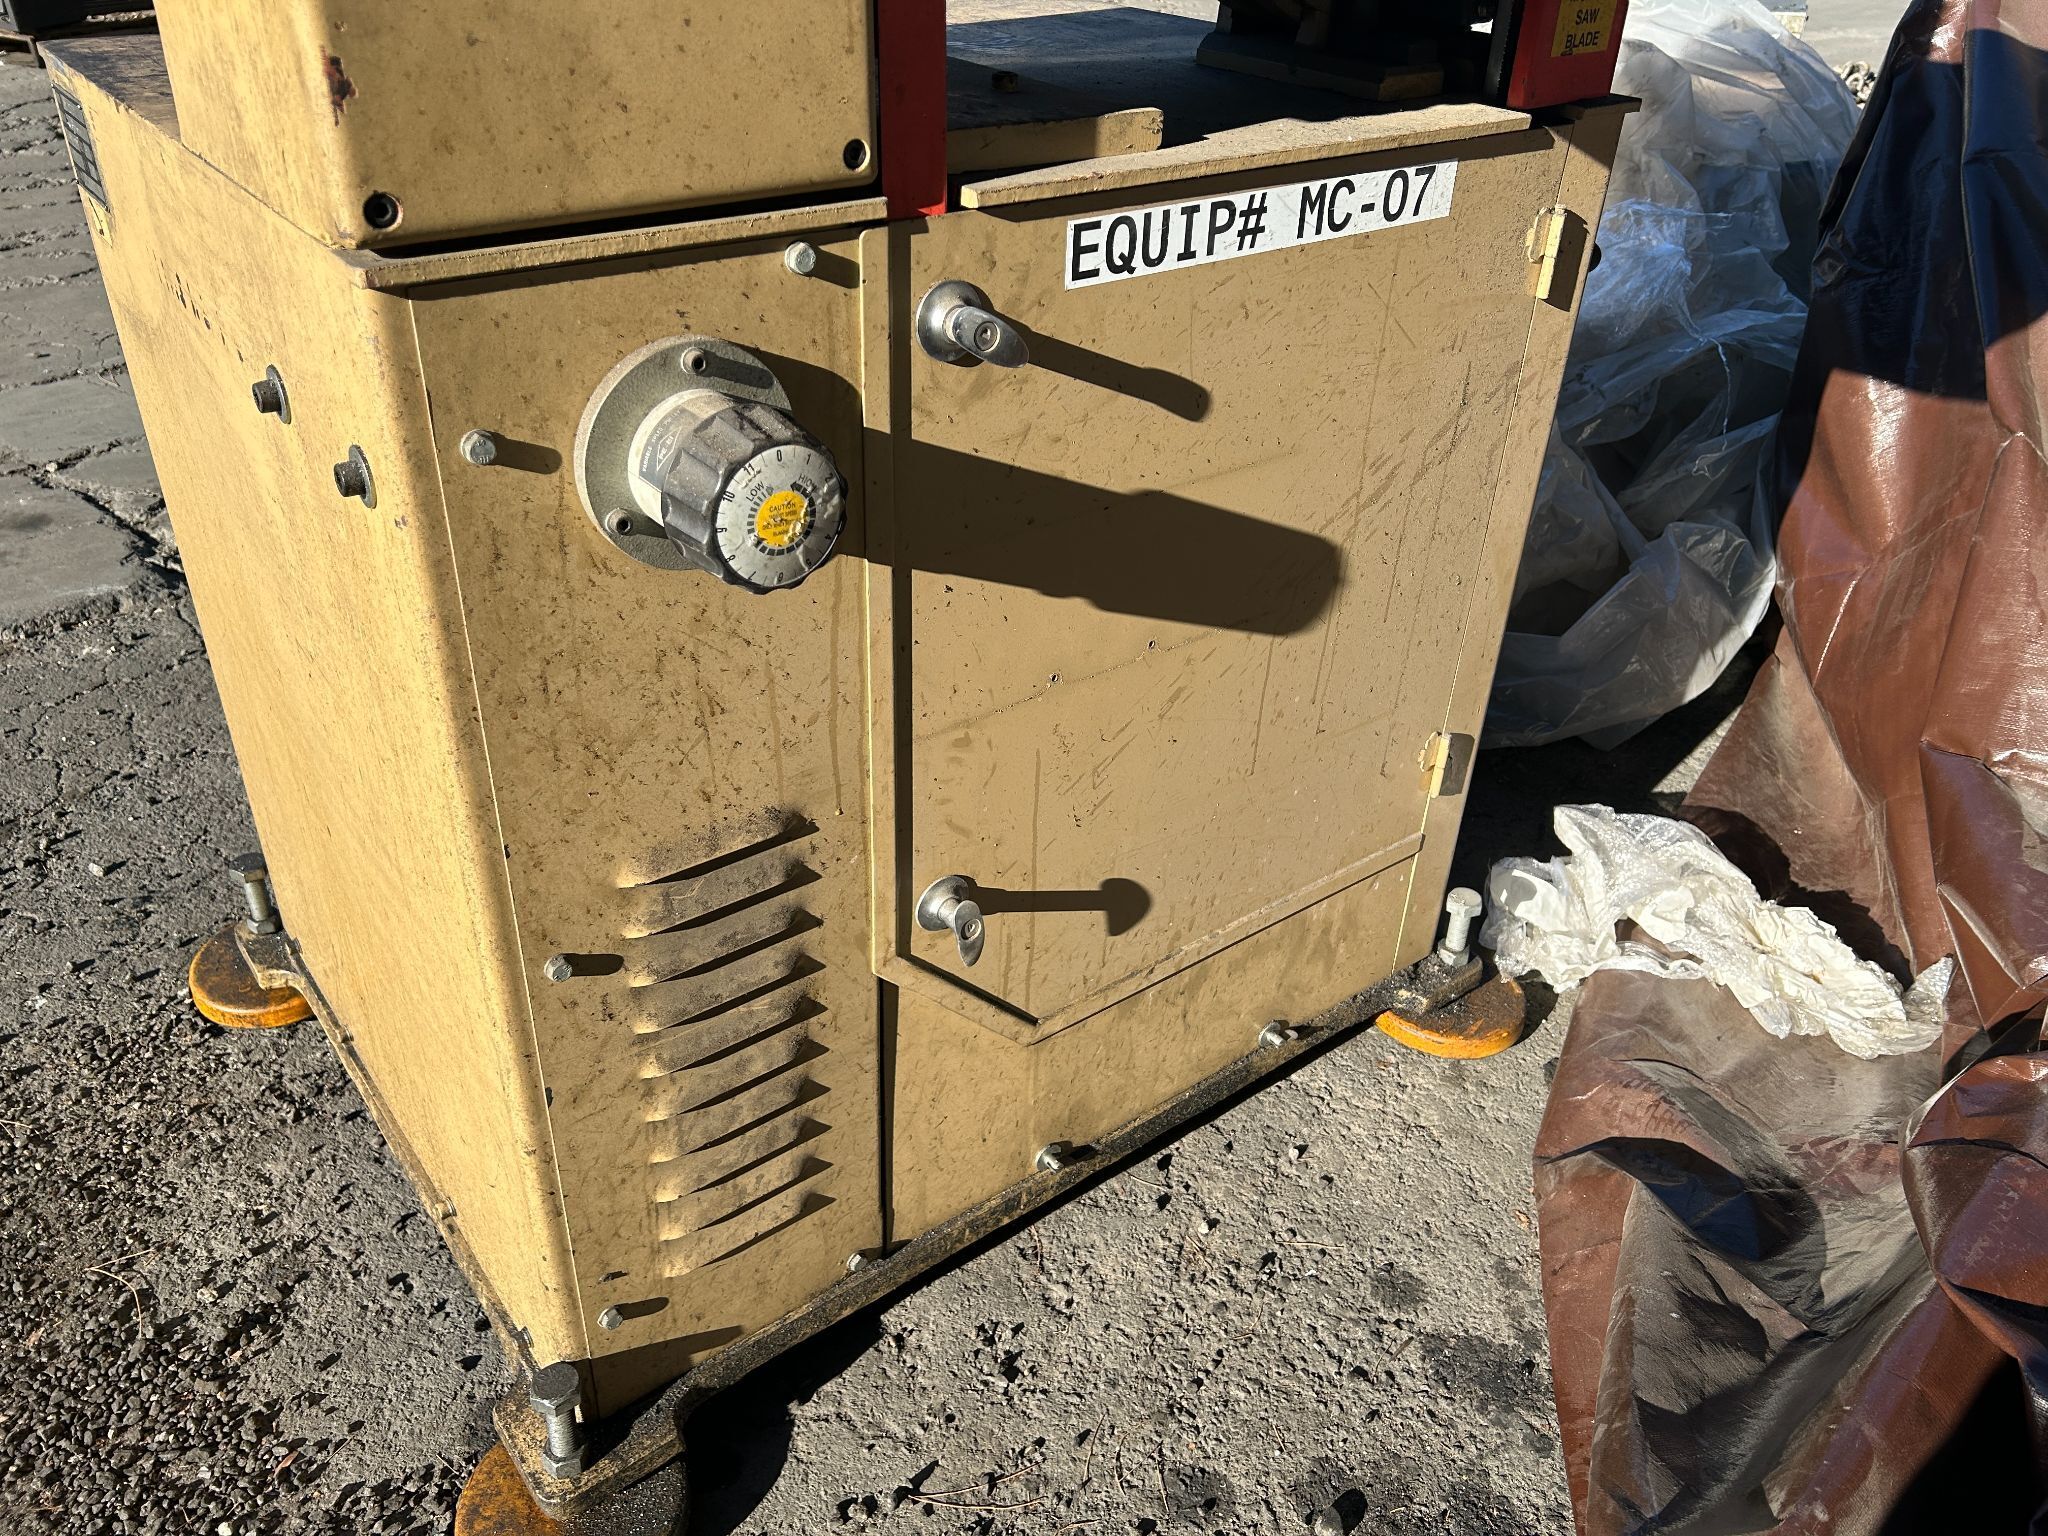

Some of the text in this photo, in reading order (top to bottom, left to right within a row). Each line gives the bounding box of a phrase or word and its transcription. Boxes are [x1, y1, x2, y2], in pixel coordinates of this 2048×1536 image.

[1575, 8, 1600, 26] SAW
[1565, 31, 1600, 49] BLADE
[1071, 164, 1437, 281] EQUIP# MC-07
[776, 449, 783, 463] 0
[805, 453, 812, 465] 1
[743, 462, 756, 476] 11
[722, 490, 736, 503] 10
[745, 480, 765, 502] LOW
[769, 502, 797, 513] CAUTION
[725, 554, 736, 563] 8
